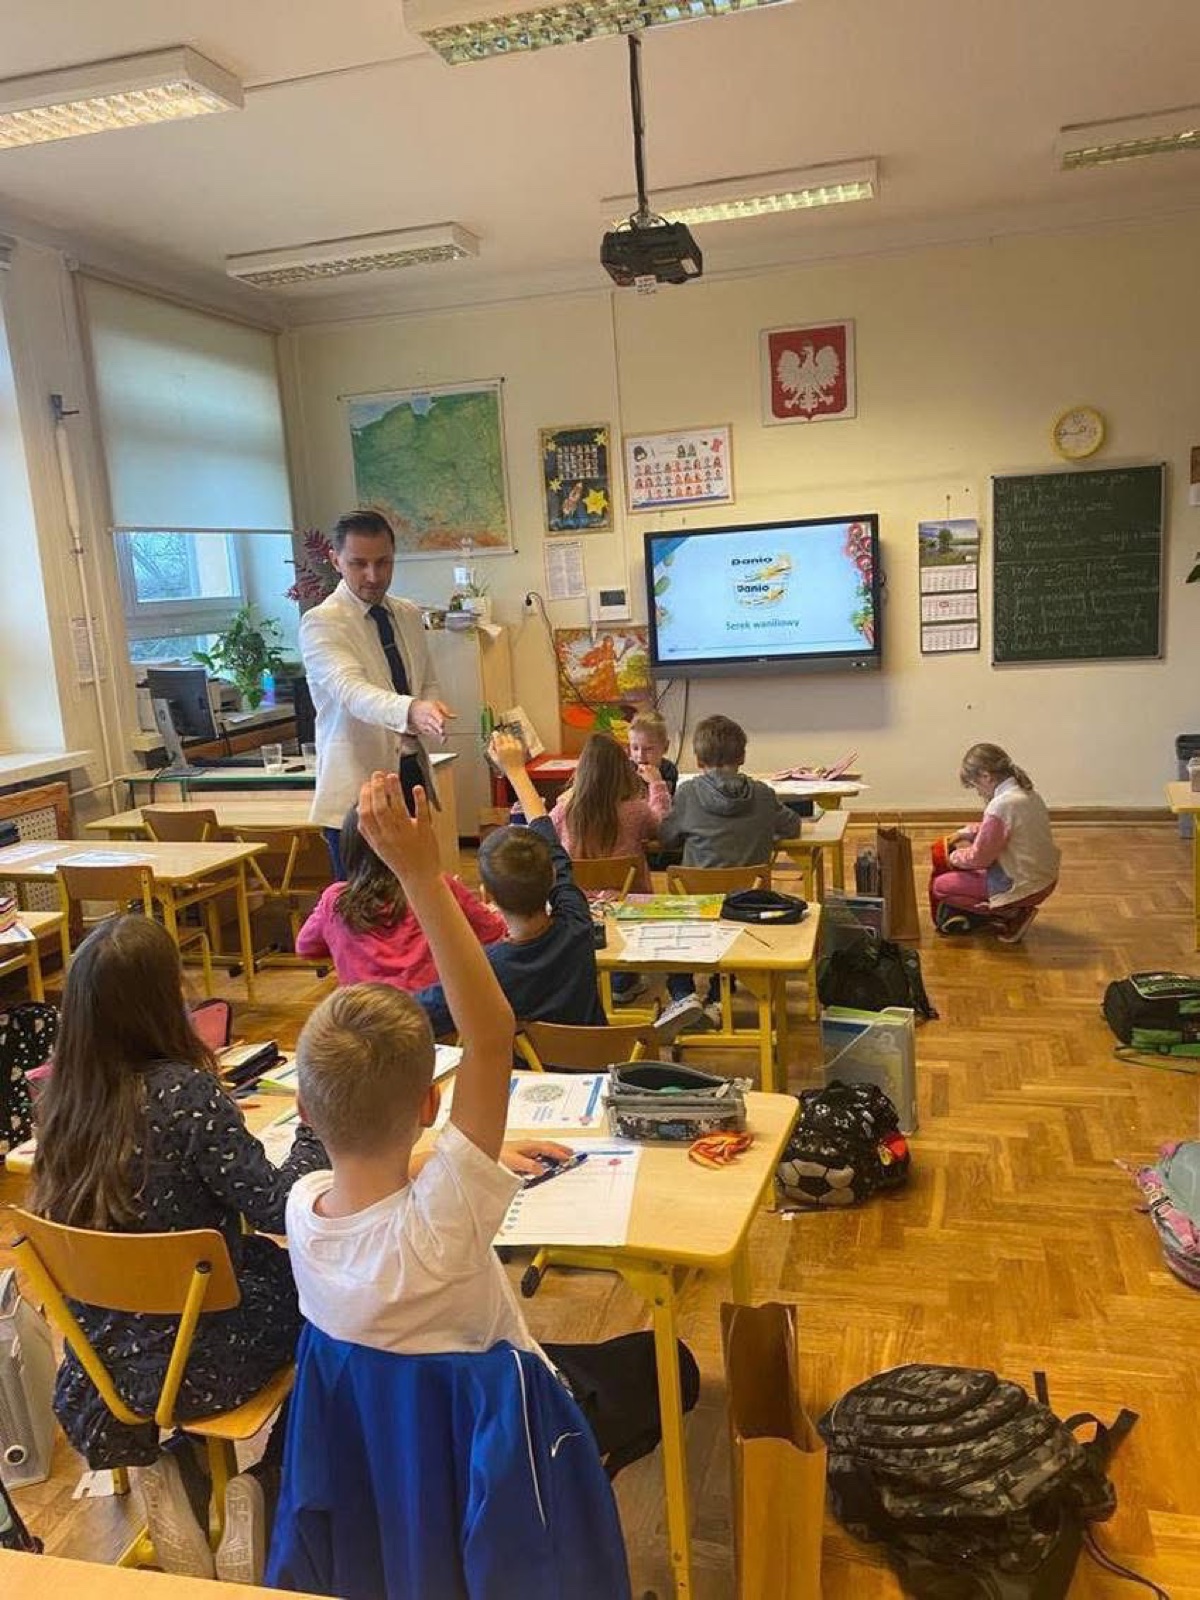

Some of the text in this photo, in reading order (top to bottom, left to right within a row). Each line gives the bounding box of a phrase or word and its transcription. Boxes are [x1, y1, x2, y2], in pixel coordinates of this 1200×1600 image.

[731, 556, 773, 566] Danio
[737, 585, 770, 593] Danio
[726, 620, 751, 630] Serek
